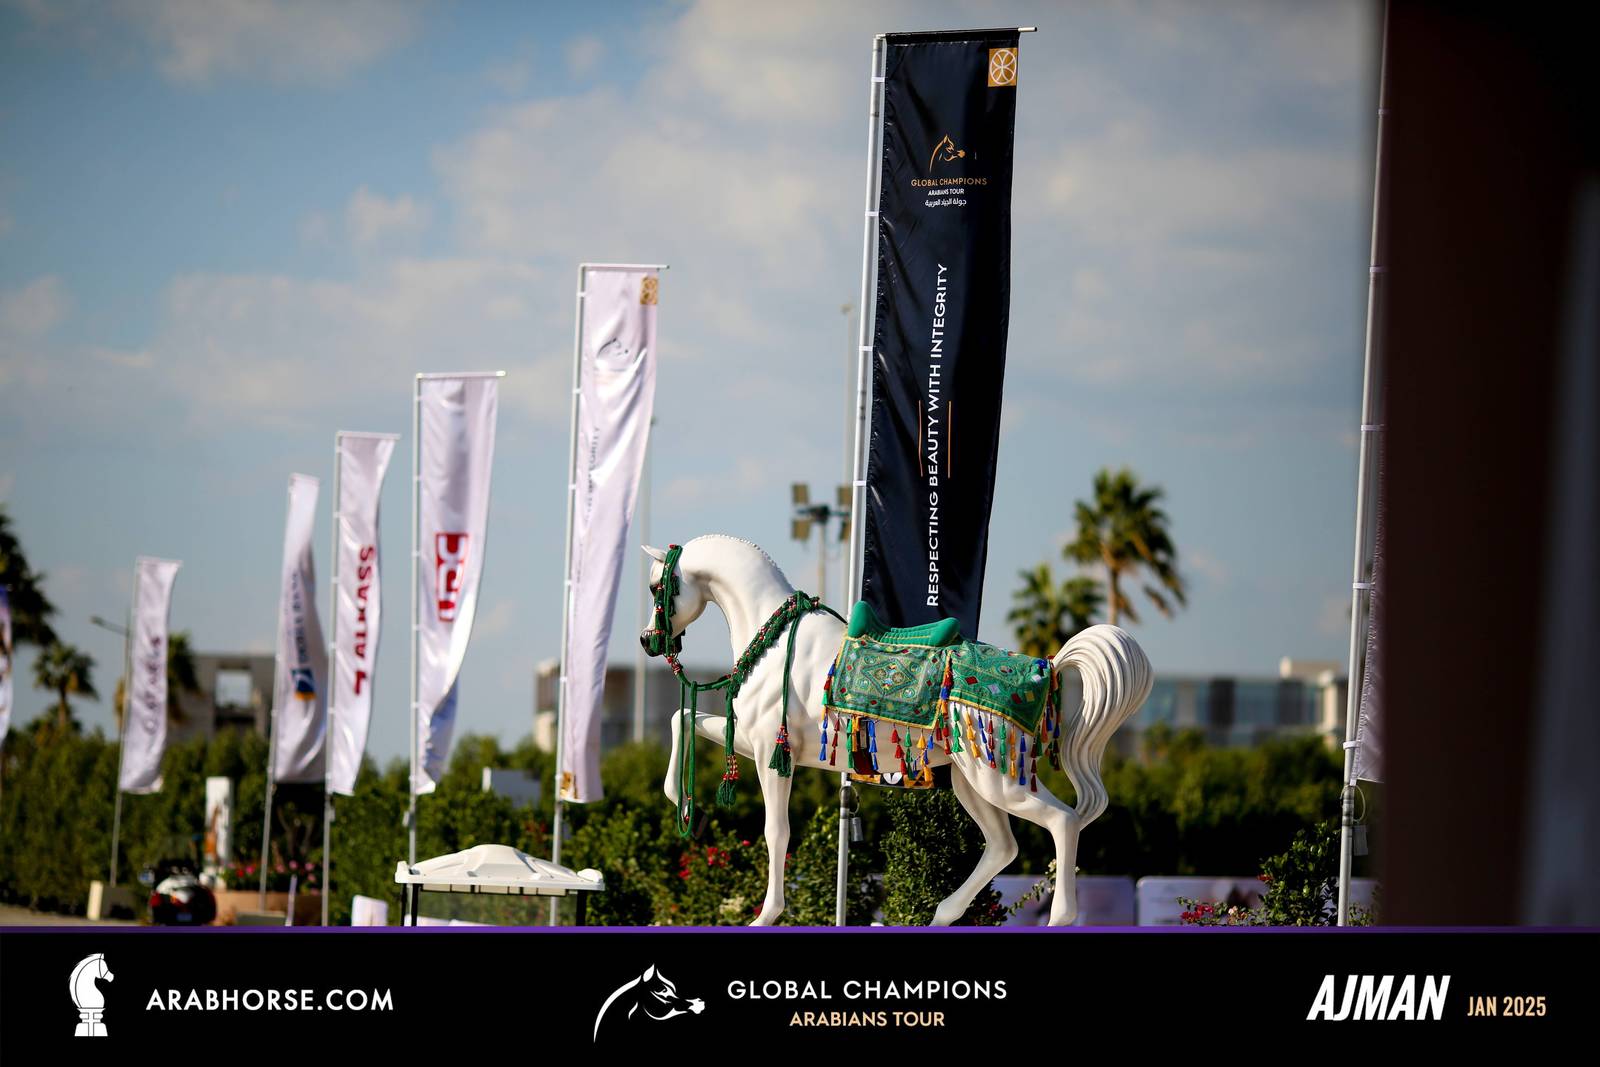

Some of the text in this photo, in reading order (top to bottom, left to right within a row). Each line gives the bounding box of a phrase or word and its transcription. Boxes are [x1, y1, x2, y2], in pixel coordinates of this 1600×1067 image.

[911, 177, 988, 187] GLOBAL CHAMPIONS
[952, 198, 967, 207] جولة
[926, 263, 948, 607] RESPECTING BEAUTY WITH INTEGRITY
